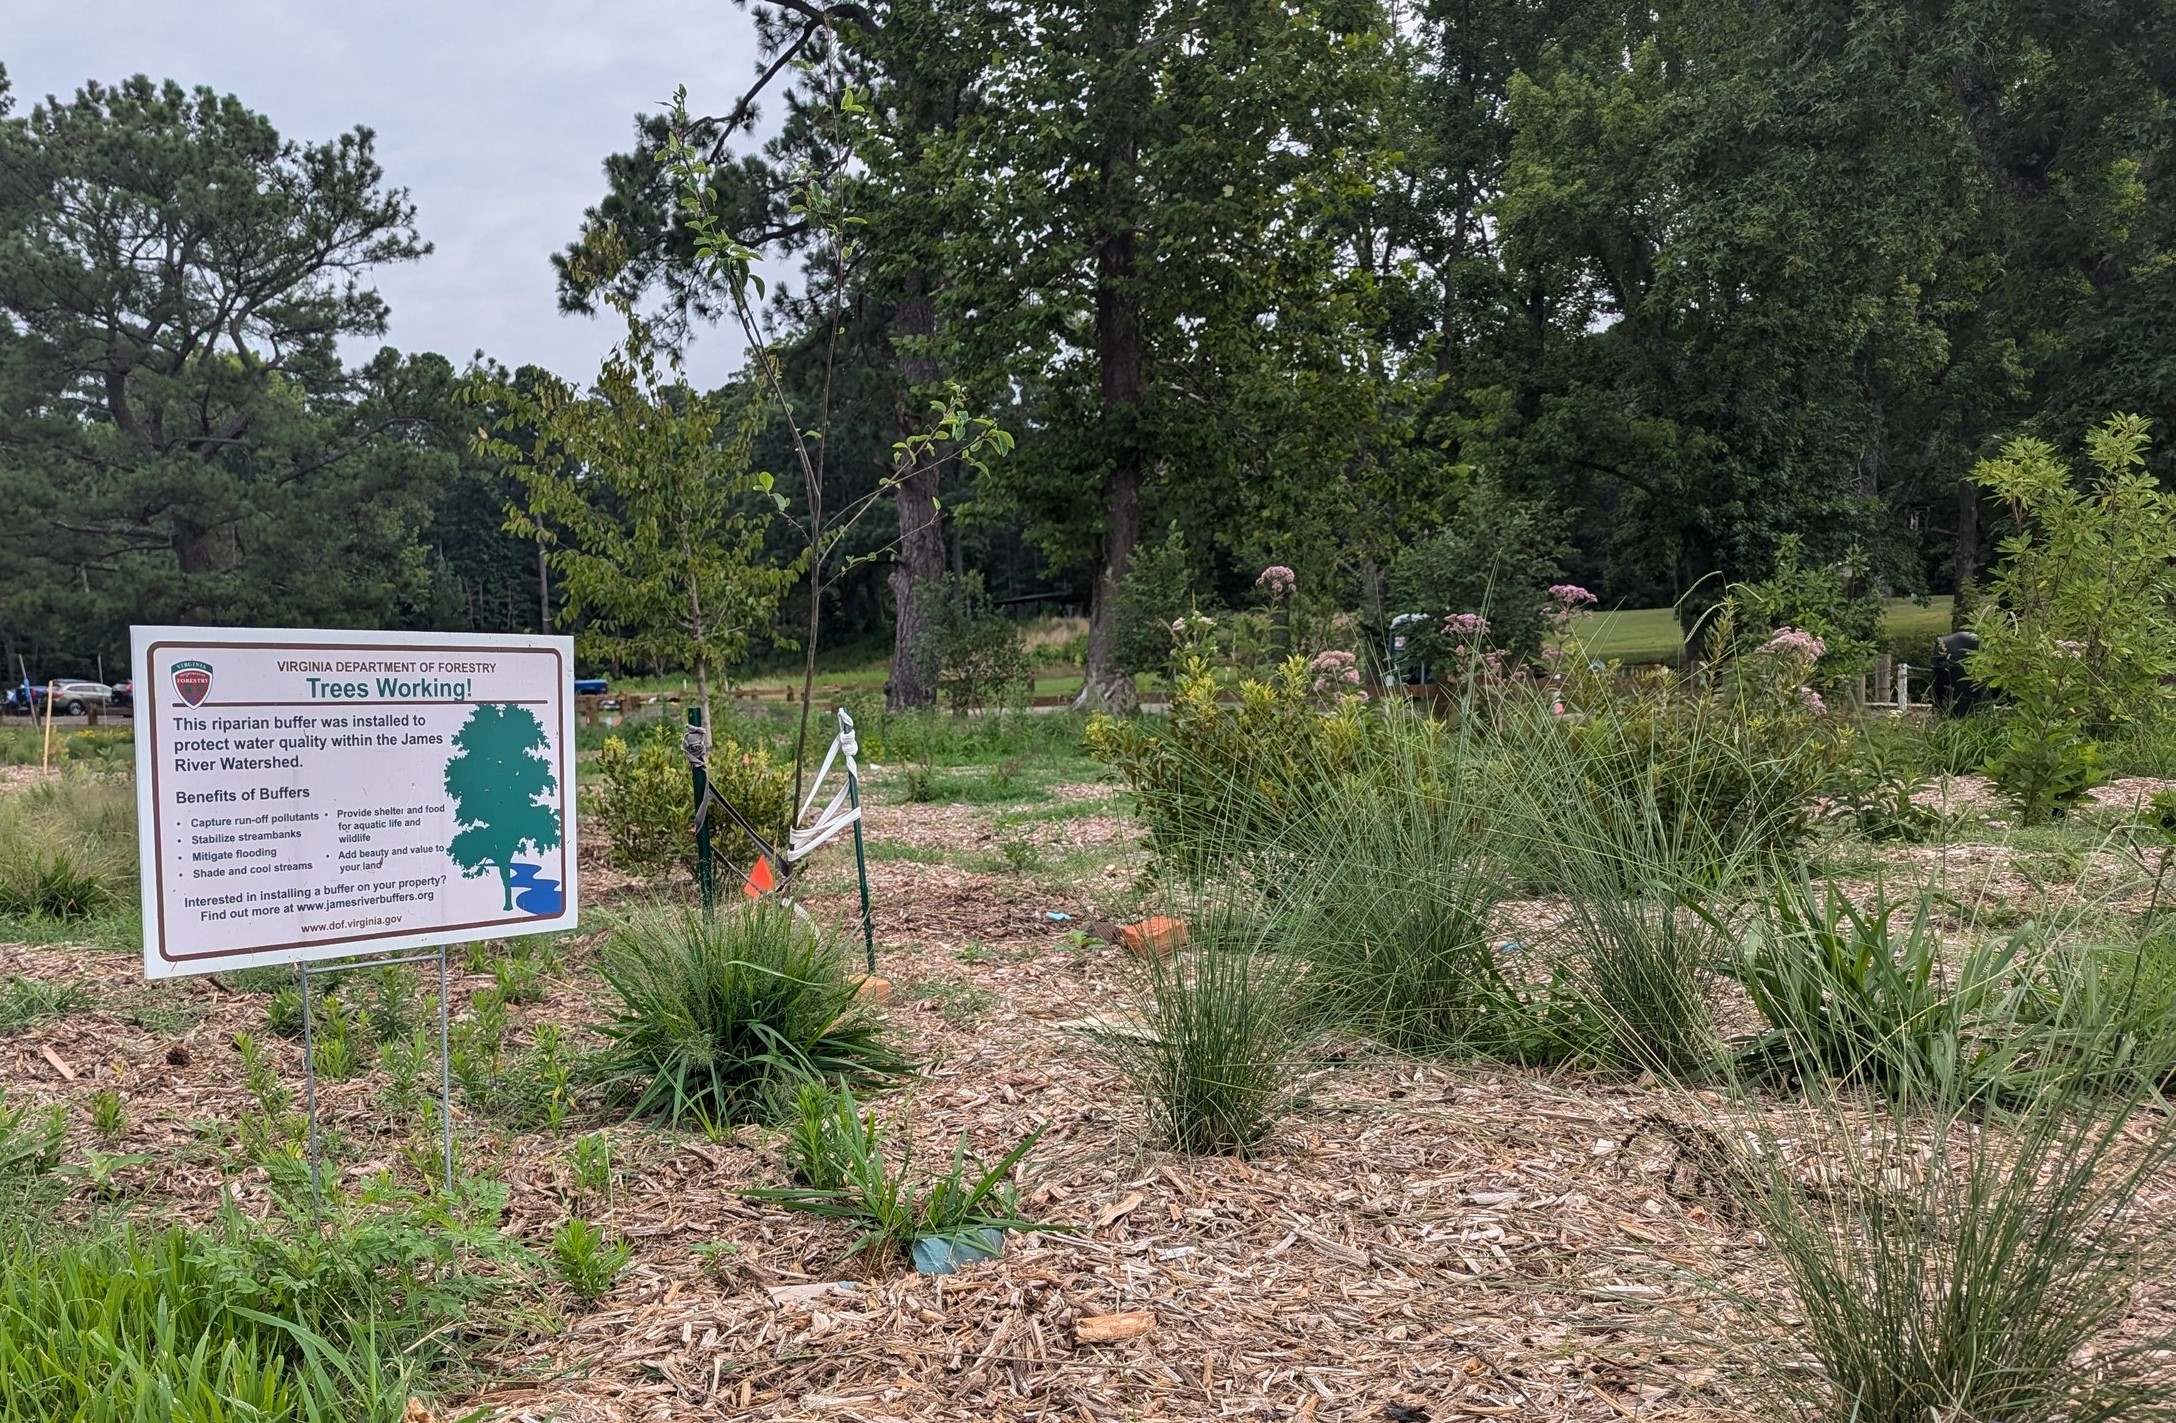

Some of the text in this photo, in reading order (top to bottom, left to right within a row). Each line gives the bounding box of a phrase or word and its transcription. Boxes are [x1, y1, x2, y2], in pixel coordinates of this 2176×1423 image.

[277, 661, 496, 673] VIRGINIA DEPARTMENT OF FORESTRY
[306, 677, 472, 701] Trees Working!
[173, 714, 426, 733] This riparian buffer was installed to
[174, 733, 443, 754] protect water quality within the James
[175, 755, 303, 772] River Watershed.
[176, 787, 310, 804] Benefits of Buffers
[337, 804, 445, 818] Provide shelter and food
[191, 812, 319, 828] Capture run-off pollutants
[338, 818, 421, 831] for aquatic life and
[192, 830, 302, 845] Stabilize streambanks
[338, 833, 371, 843] wildlife
[192, 848, 277, 862] Mitigate flooding
[338, 844, 445, 859] Add beauty and value to
[193, 862, 313, 878] Shade and cool streams
[340, 861, 382, 874] your land
[184, 875, 447, 908] Interested in installing a buffer on your property?
[200, 892, 434, 921] Find out more at www.jamesriverbuffers.org
[301, 915, 402, 933] www.dof.virginia.gov
